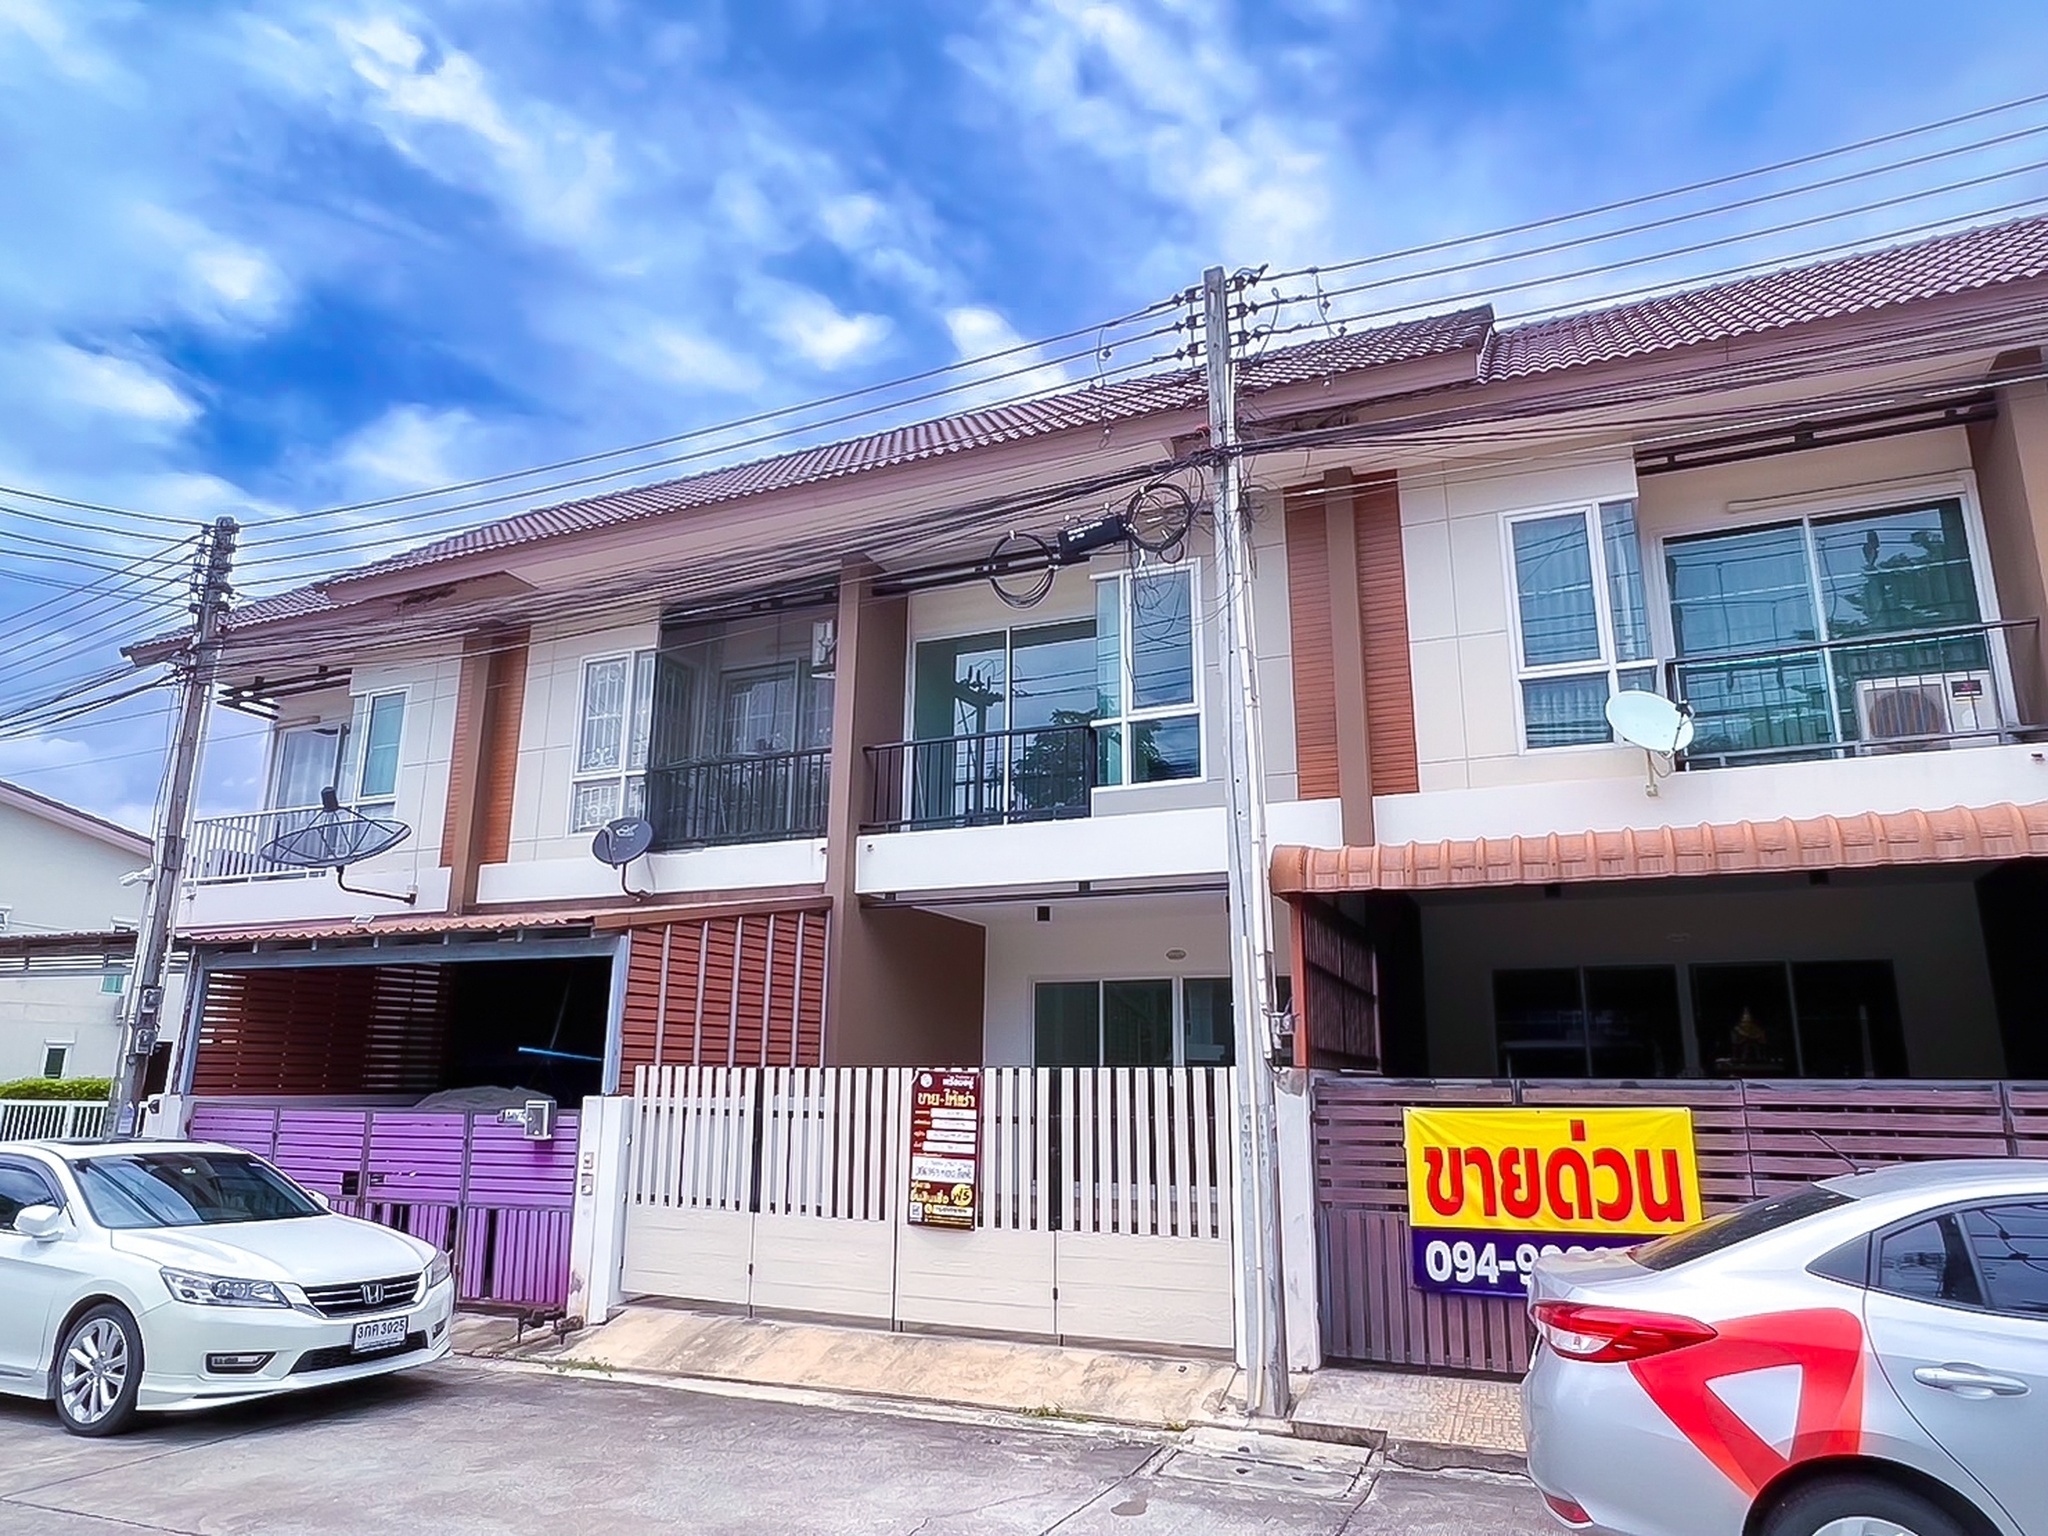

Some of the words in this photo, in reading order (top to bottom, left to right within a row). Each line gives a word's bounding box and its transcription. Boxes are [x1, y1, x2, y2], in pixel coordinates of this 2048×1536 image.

[1424, 1119, 1685, 1222] ขายด่วน
[1425, 1240, 1610, 1285] 094-9
[380, 1319, 405, 1335] 3025
